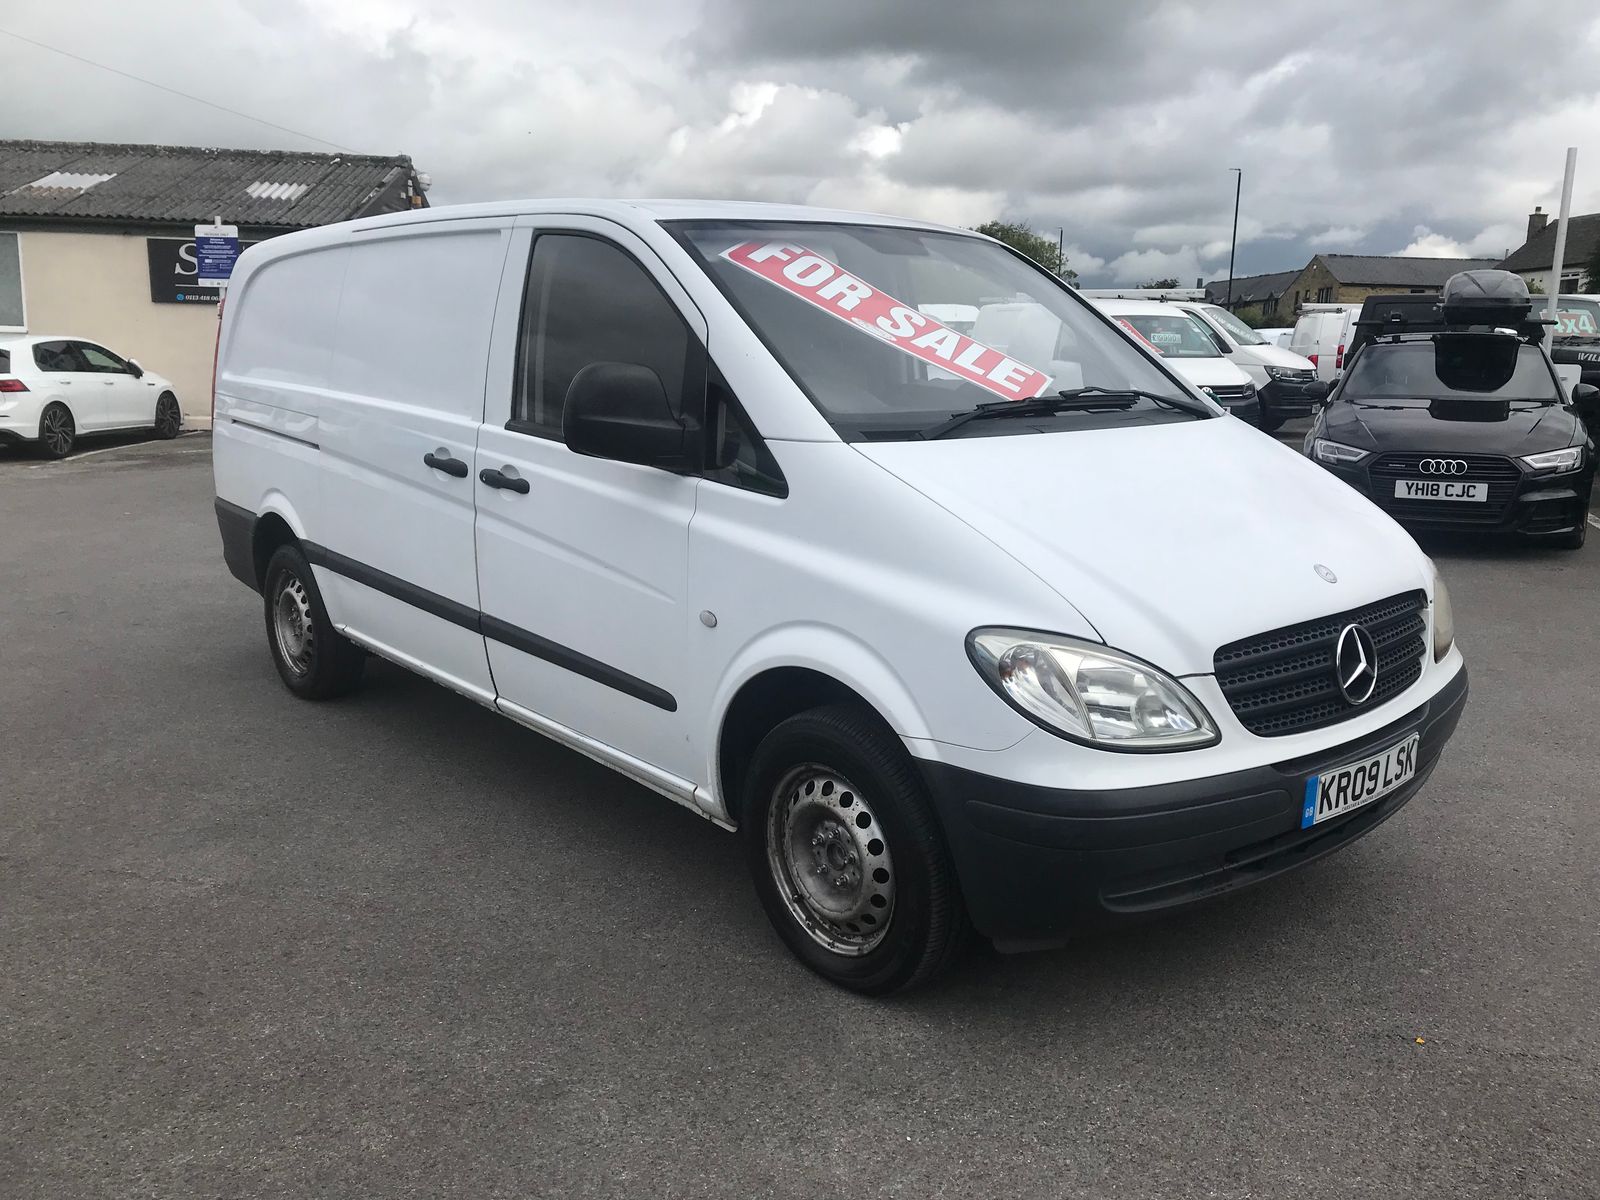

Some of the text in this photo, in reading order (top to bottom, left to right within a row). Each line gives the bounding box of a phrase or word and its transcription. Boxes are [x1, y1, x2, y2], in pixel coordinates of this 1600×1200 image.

[746, 242, 1036, 393] FOR SALE
[1405, 481, 1477, 498] YH18 CJC
[1318, 738, 1417, 815] KR09 LSK
[1304, 806, 1314, 818] GB
